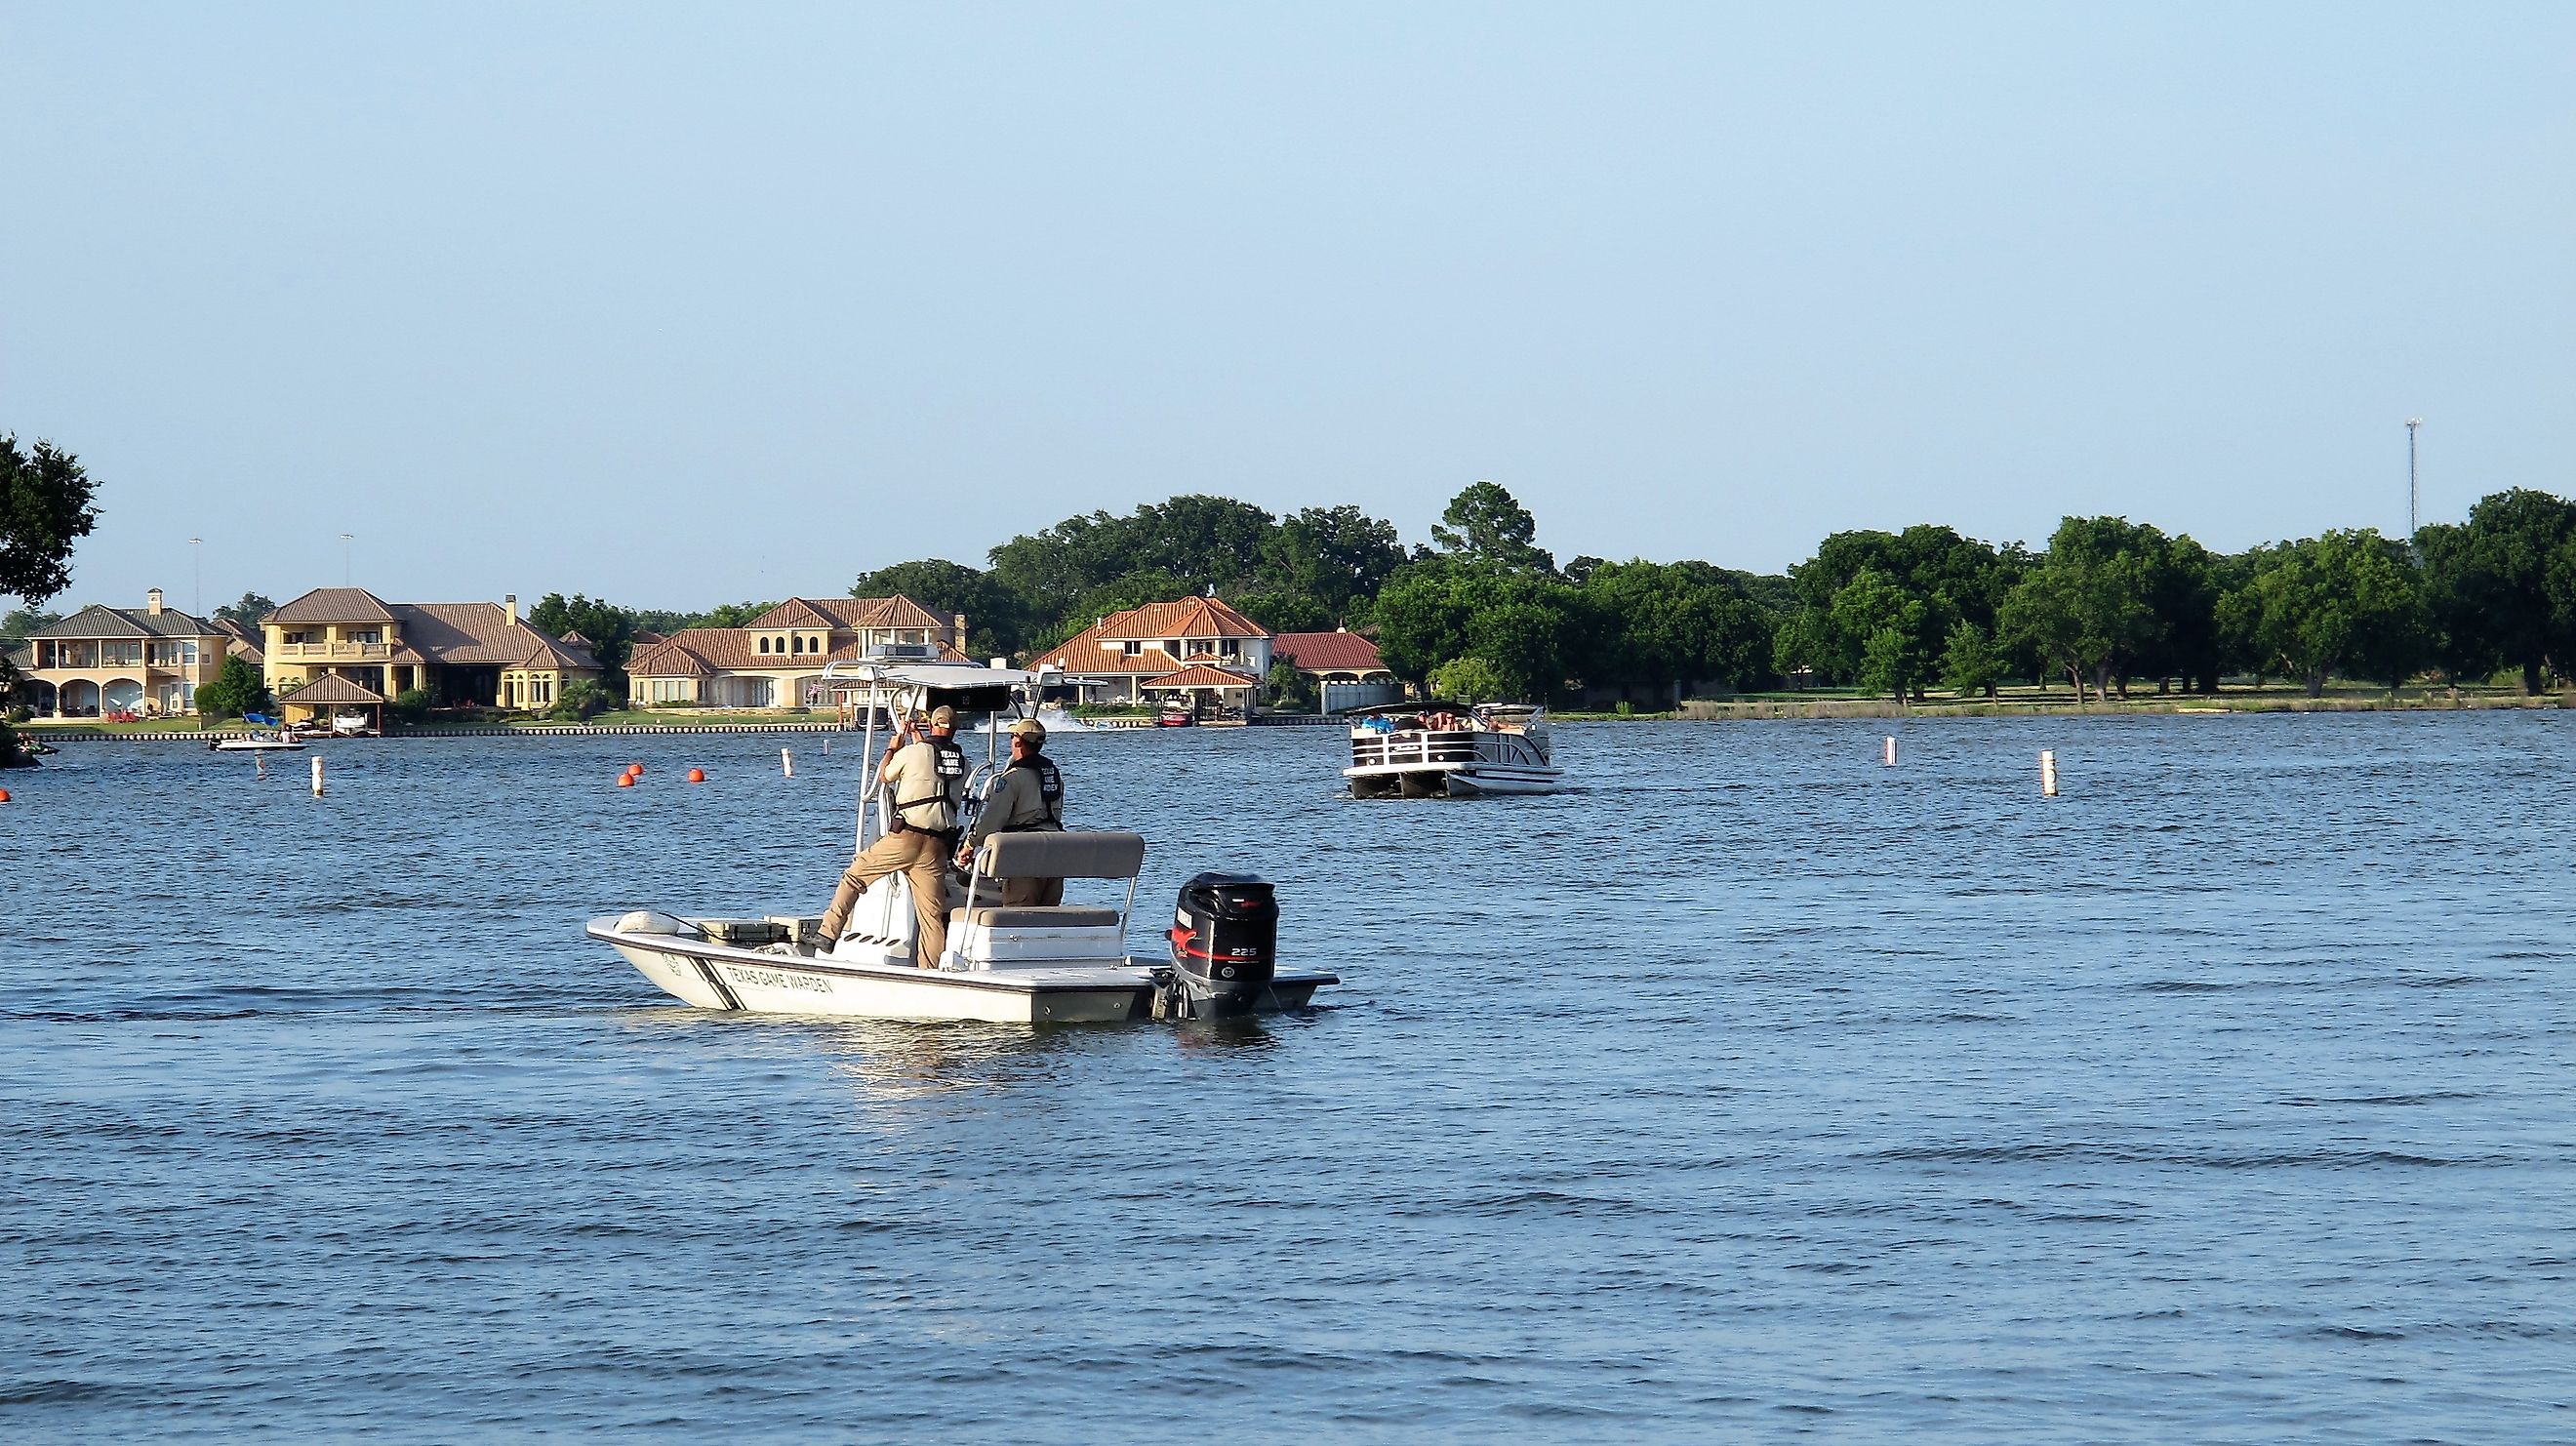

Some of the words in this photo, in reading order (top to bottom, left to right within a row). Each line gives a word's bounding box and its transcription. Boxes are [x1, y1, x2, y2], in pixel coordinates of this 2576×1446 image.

[940, 749, 960, 758] TEXAS
[942, 758, 959, 767] GAME
[937, 766, 962, 775] WARDEN
[1231, 947, 1257, 956] 225
[726, 966, 759, 985] TEXAS
[758, 971, 787, 988] GAME
[786, 975, 833, 993] WARDEN
